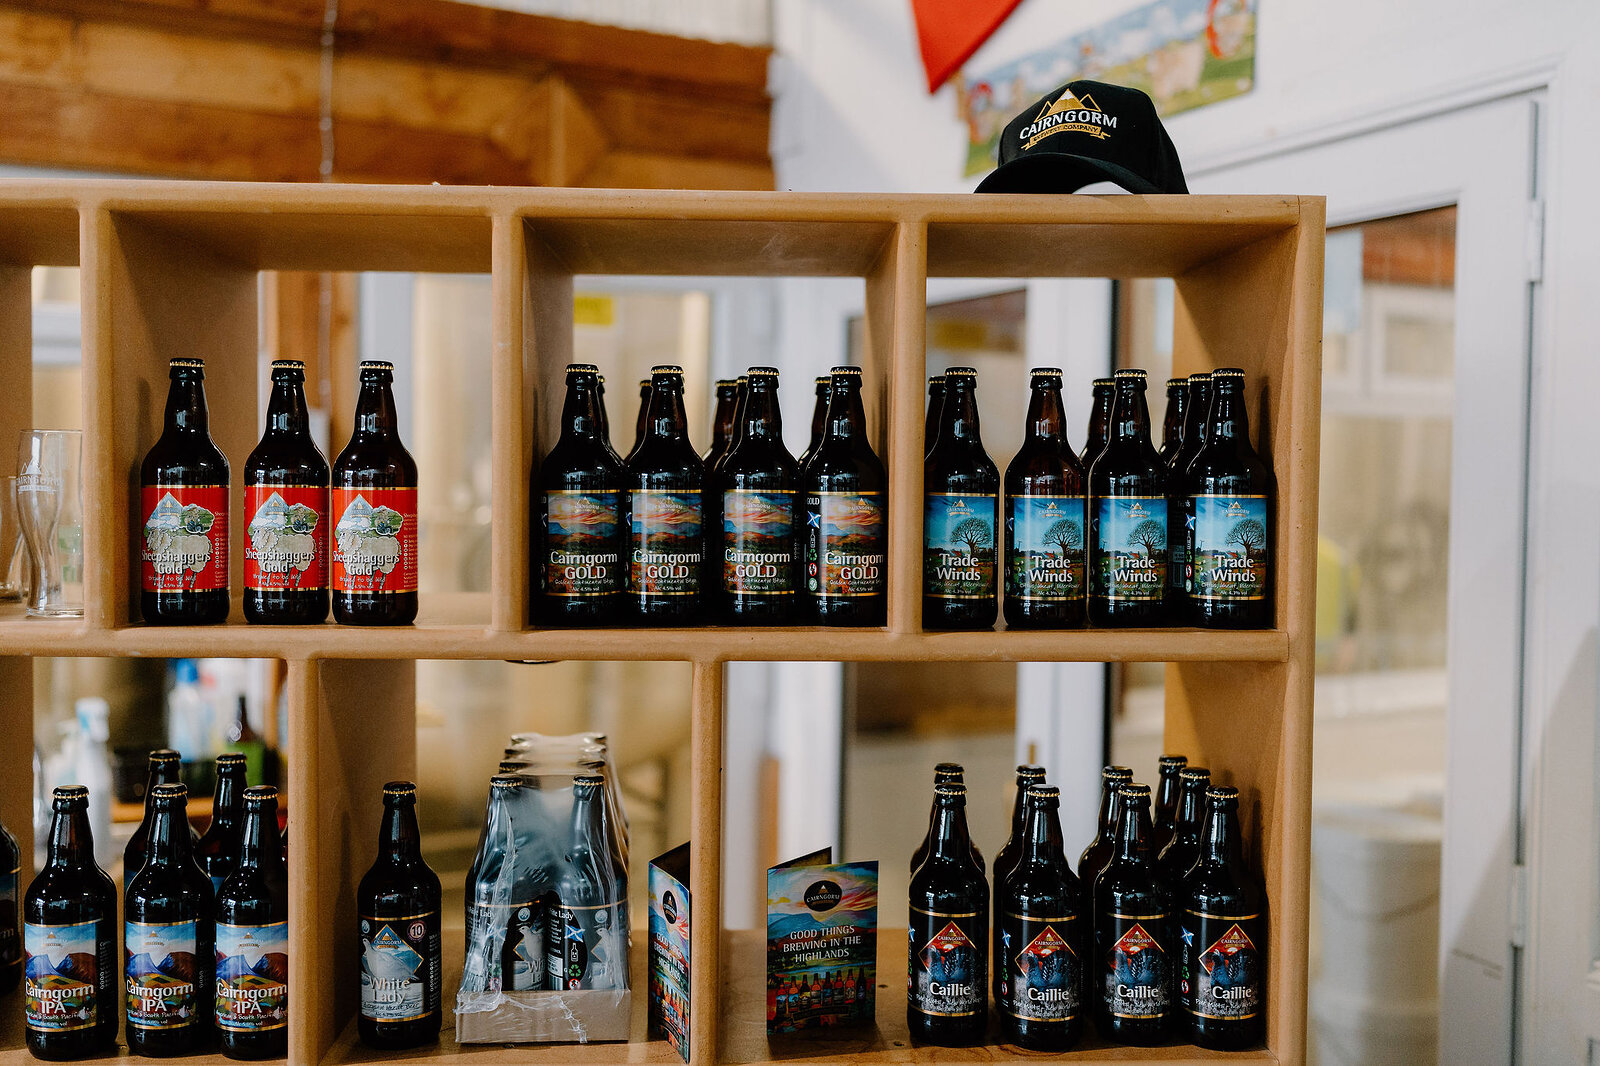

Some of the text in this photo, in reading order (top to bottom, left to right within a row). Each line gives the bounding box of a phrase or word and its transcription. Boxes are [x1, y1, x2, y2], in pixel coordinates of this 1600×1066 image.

[1019, 110, 1118, 139] CAIRNGORM
[1063, 124, 1099, 133] COMPANY
[142, 550, 211, 564] Sheepshaggers
[246, 548, 314, 562] Sheepshaggers
[333, 551, 400, 566] Sheepshaggers
[550, 551, 618, 566] Cairngorm
[634, 550, 700, 566] Cairngorm
[725, 549, 790, 566] Cairngorm
[939, 554, 978, 567] Trade
[1032, 556, 1070, 568] Trade
[1117, 556, 1155, 568] Trade
[1214, 556, 1254, 568] Trade
[158, 564, 183, 574] Gold
[263, 562, 289, 572] Gold
[348, 565, 373, 576] Gold
[565, 566, 607, 580] GOLD
[647, 565, 689, 578] GOLD
[736, 565, 777, 578] GOLD
[840, 566, 878, 580] GOLD
[936, 568, 981, 581] Winds
[1029, 570, 1073, 582] Winds
[1114, 570, 1158, 582] Winds
[1212, 570, 1256, 582] Winds
[806, 893, 840, 903] CAIRNGORM
[558, 910, 574, 920] Lady
[412, 925, 423, 936] 10
[790, 925, 855, 940] GOOD THINGS
[783, 936, 862, 953] BREWING IN THE
[795, 949, 850, 963] HIGHLANDS
[126, 980, 194, 1000] Cairngorm
[370, 978, 410, 990] White
[930, 982, 971, 996] Caillie
[1117, 984, 1159, 998] Caillie
[26, 982, 94, 1002] Cairngorm
[217, 982, 287, 1002] Cairngorm
[373, 990, 406, 1004] Lady
[1028, 988, 1070, 1001] Caillie
[1212, 986, 1252, 1000] Caillie
[40, 1001, 66, 1014] IPA
[141, 998, 168, 1012] IPA
[236, 1000, 262, 1014] IPA
